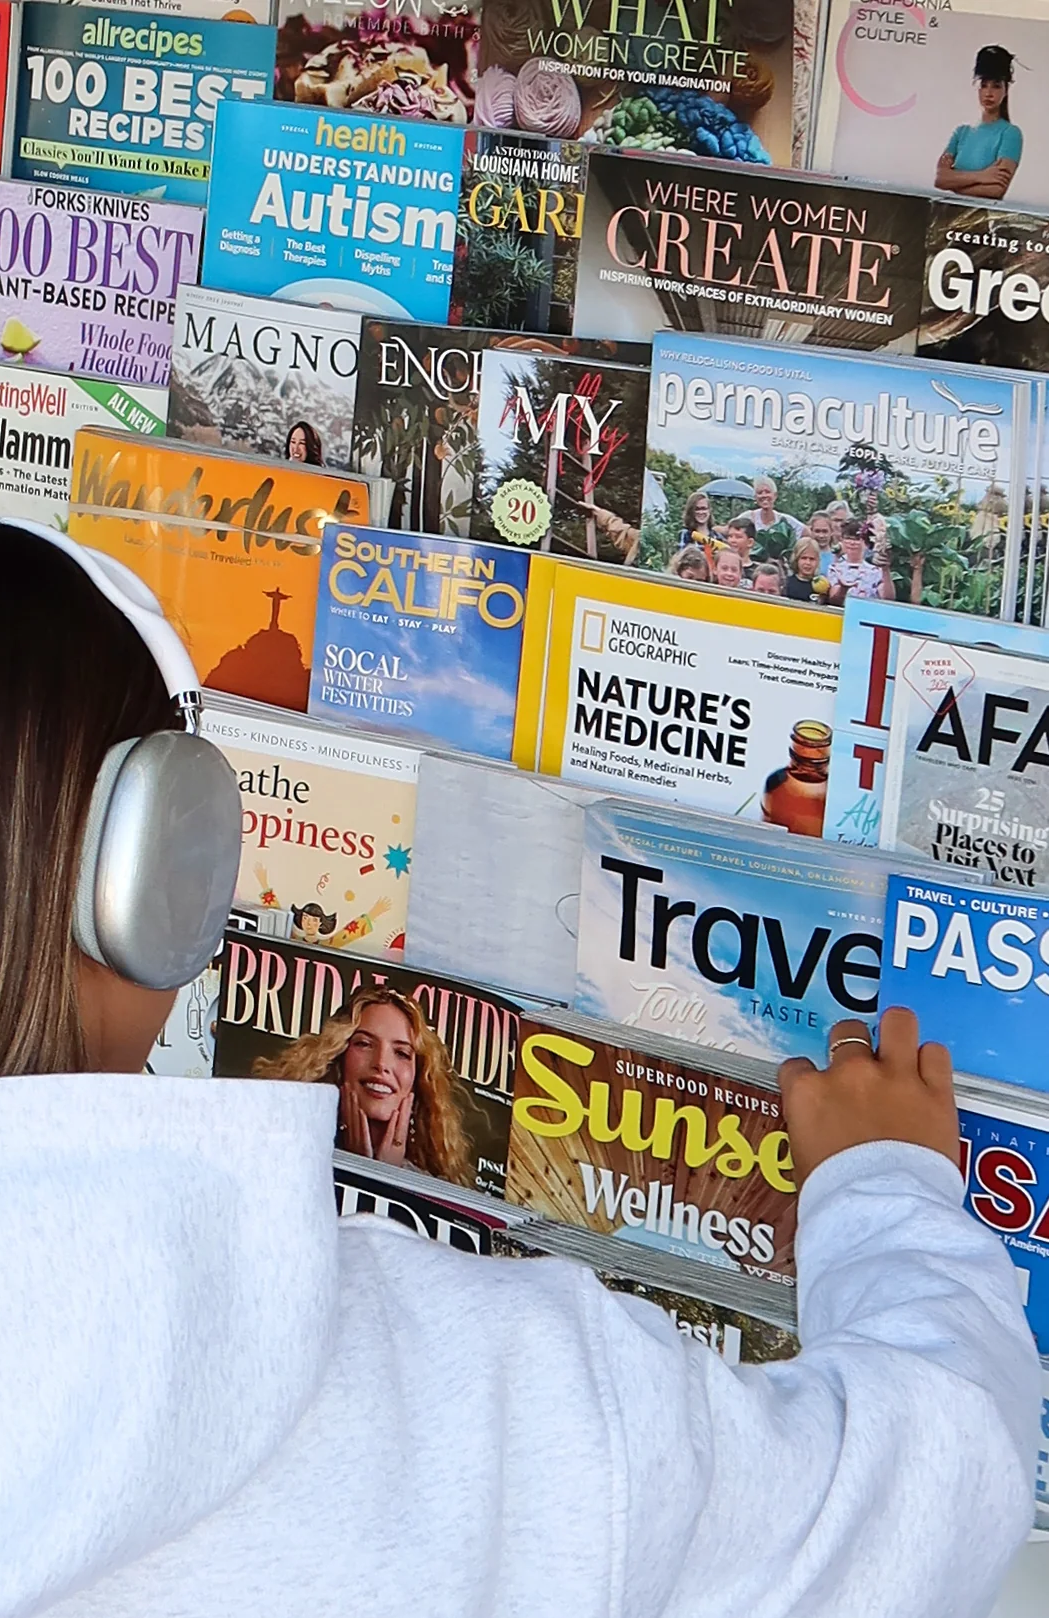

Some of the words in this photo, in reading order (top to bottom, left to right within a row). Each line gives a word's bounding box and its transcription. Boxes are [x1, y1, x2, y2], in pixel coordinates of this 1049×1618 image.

[82, 17, 203, 58] allrecipes
[528, 29, 629, 64] WOMEN
[643, 42, 749, 78] CREATE
[855, 26, 926, 45] CULTURE
[25, 55, 107, 103] 100
[123, 65, 267, 122] BEST
[538, 60, 600, 78] INSPIRATION
[603, 67, 624, 81] FOR
[626, 69, 656, 84] YOUR
[658, 73, 730, 94] IMAGINATION
[68, 108, 205, 150] RECIPES
[316, 116, 406, 156] health
[264, 148, 453, 192] UNDERSTANDING
[35, 189, 86, 213] FORKS
[93, 198, 150, 222] KNIVES
[250, 172, 455, 251] Autism
[646, 179, 738, 217] WHERE
[750, 196, 867, 235] WOMEN
[66, 213, 194, 300] BEST
[220, 241, 261, 257] Diagnosis
[283, 251, 326, 268] Therapies
[606, 205, 893, 308] CREATE
[946, 230, 1019, 253] creating
[600, 270, 652, 288] INSPIRING
[654, 278, 685, 292] WORK
[685, 282, 726, 300] SPACES
[728, 290, 744, 303] OF
[745, 294, 844, 318] EXTRAORDINARY
[844, 308, 893, 326] WOMEN
[182, 312, 360, 378] MAGNO
[107, 392, 128, 418] ALL
[127, 406, 157, 435] NEW
[510, 386, 623, 455] MY
[658, 371, 999, 463] permaculture
[13, 468, 32, 482] The
[35, 472, 68, 487] Latest
[771, 437, 808, 450] EARTH
[844, 447, 883, 461] PEOPLE
[922, 459, 964, 473] FUTURE
[967, 465, 996, 476] CARE
[507, 498, 536, 526] 20
[335, 532, 495, 581] SOUTHERN
[329, 560, 524, 629] CALIFO
[373, 612, 388, 625] EAT
[398, 617, 422, 630] STAY
[432, 623, 457, 635] PLAY
[611, 619, 679, 647] NATIONAL
[325, 644, 408, 681] SOCAL
[608, 638, 698, 668] GEOGRAPHIC
[322, 686, 413, 718] FESTIVITIES
[324, 668, 383, 694] WINTER
[578, 667, 751, 731] NATURE'S
[250, 731, 308, 752] KINDNESS
[318, 746, 402, 771] MINDFULNESS
[574, 703, 748, 768] MEDICINE
[570, 756, 588, 770] and
[589, 760, 626, 780] Natural
[628, 770, 677, 789] Remedies
[572, 742, 608, 761] Healing
[609, 750, 641, 767] Foods,
[644, 758, 695, 778] Medicinal
[697, 768, 732, 786] Herbs,
[935, 822, 1006, 858] Places
[1012, 841, 1035, 865] to
[907, 886, 955, 907] TRAVEL
[970, 900, 1038, 920] CULTURE
[601, 855, 883, 1014] Trave
[892, 900, 1049, 997] PAS
[221, 938, 390, 1041] BRID
[751, 1000, 818, 1028] TASTE
[616, 1059, 709, 1098] SUPERFOOD
[715, 1086, 779, 1118] RECIPES
[513, 1033, 797, 1193] Sunse
[578, 1161, 775, 1263] Wellness
